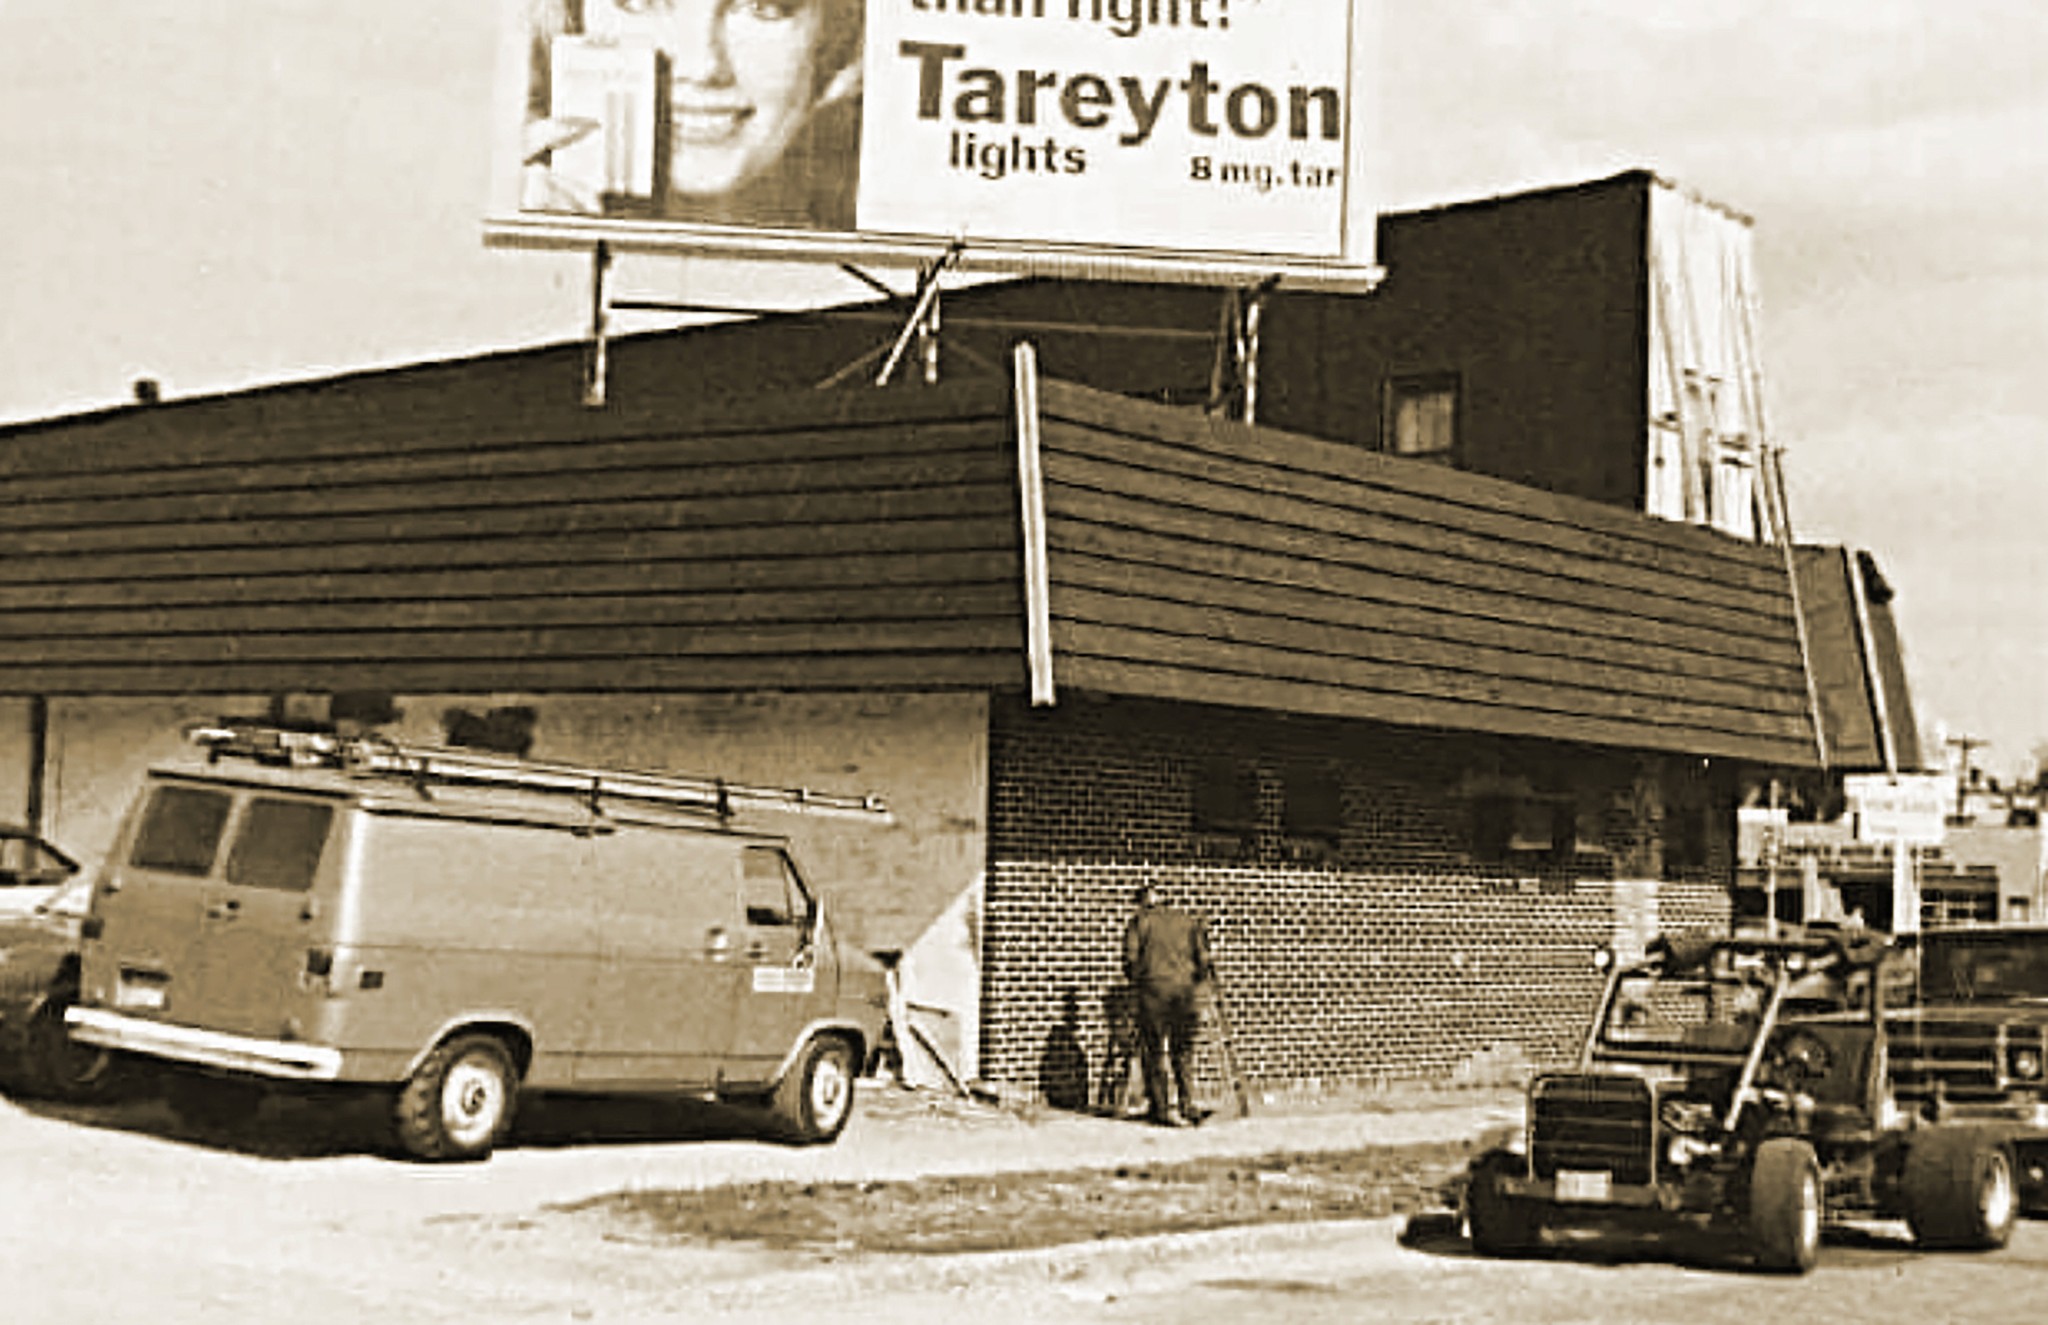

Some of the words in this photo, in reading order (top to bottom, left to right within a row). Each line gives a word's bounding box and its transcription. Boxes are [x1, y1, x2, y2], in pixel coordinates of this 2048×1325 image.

[899, 40, 1341, 146] Tareyton
[950, 131, 1087, 180] lights
[1190, 156, 1212, 181] 8
[1291, 161, 1341, 187] tar
